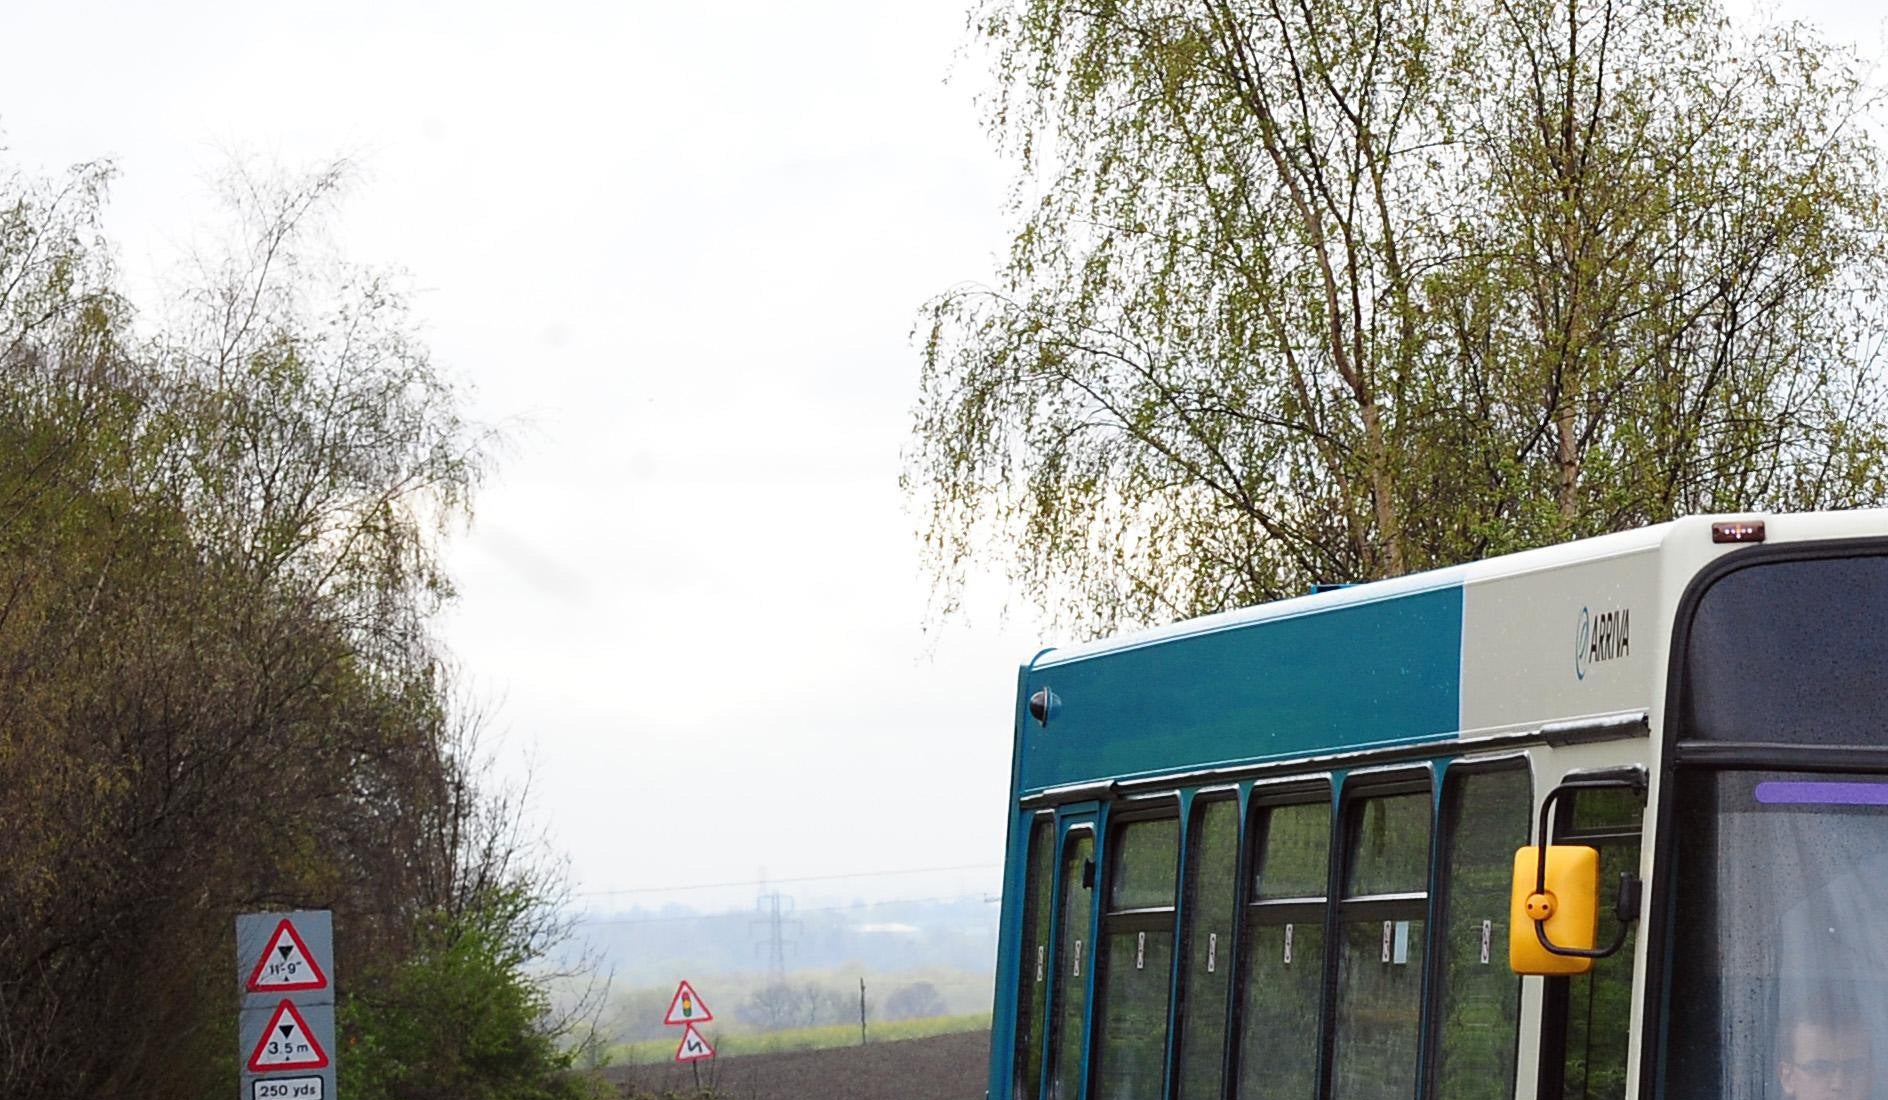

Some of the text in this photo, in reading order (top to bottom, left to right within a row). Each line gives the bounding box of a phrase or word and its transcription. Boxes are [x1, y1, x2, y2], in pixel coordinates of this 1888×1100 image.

[1588, 608, 1629, 663] ARRIVA
[297, 1044, 308, 1053] m
[260, 1084, 316, 1097] 250 yds
